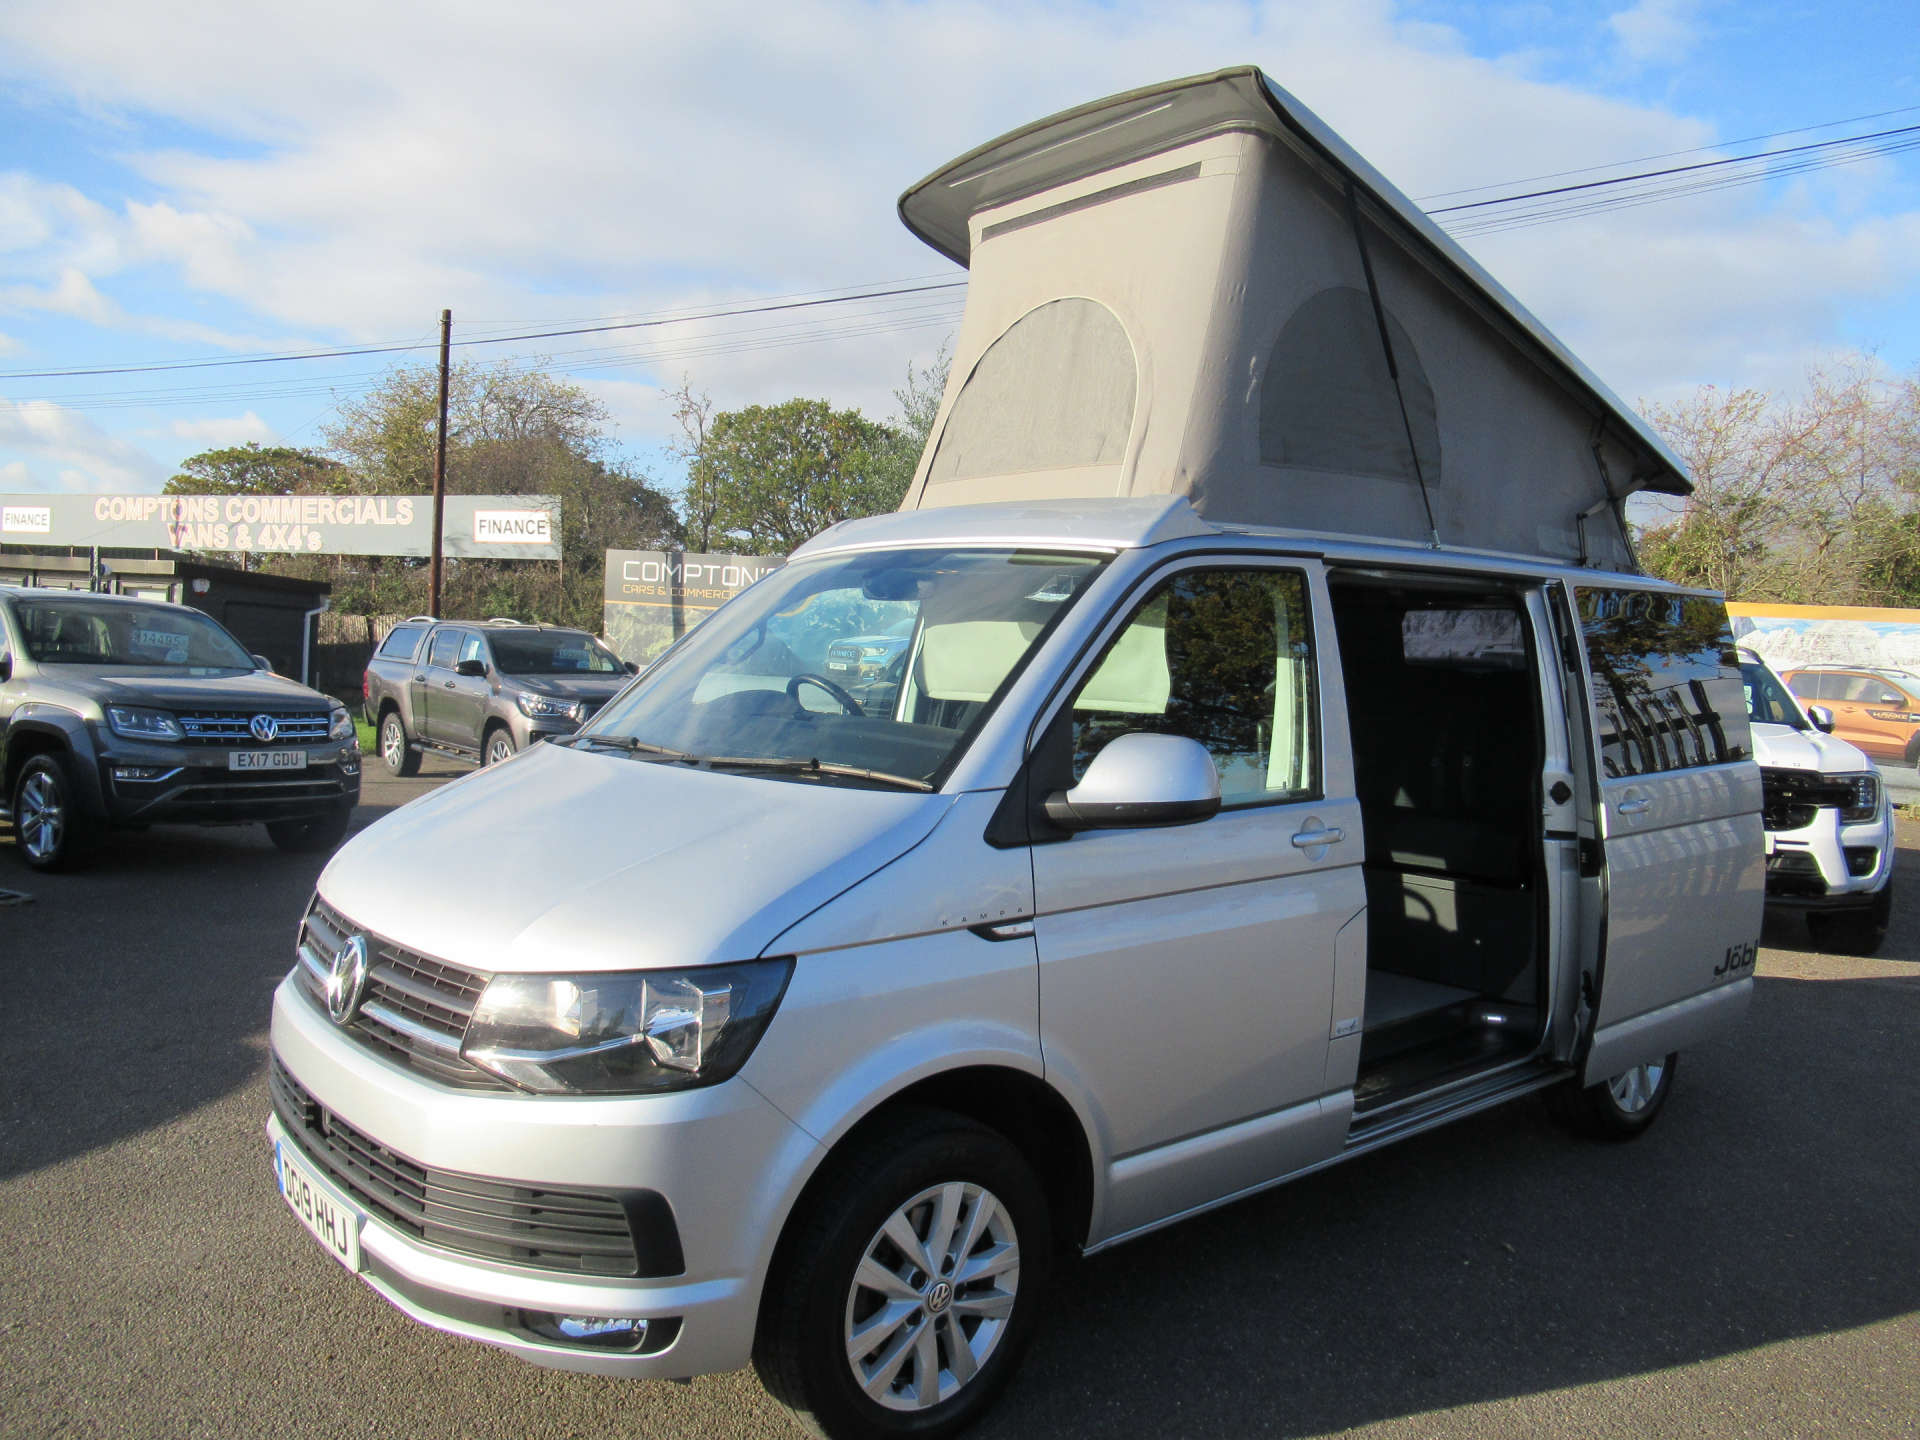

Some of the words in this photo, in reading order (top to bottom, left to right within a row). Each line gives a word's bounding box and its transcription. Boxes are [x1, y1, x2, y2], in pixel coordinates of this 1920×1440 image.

[94, 496, 219, 523] COMPTONS
[225, 498, 415, 525] COMMERCIALS
[5, 512, 48, 527] FINANCE
[478, 519, 547, 535] FINANCE
[167, 522, 229, 549] VANS
[235, 524, 253, 549] &
[257, 525, 323, 551] 4X4's
[622, 584, 655, 595] CARS
[657, 586, 666, 596] &
[237, 753, 268, 767] EX17
[272, 752, 299, 767] GDU
[283, 1159, 312, 1222] DG19
[314, 1192, 348, 1256] HHJ
